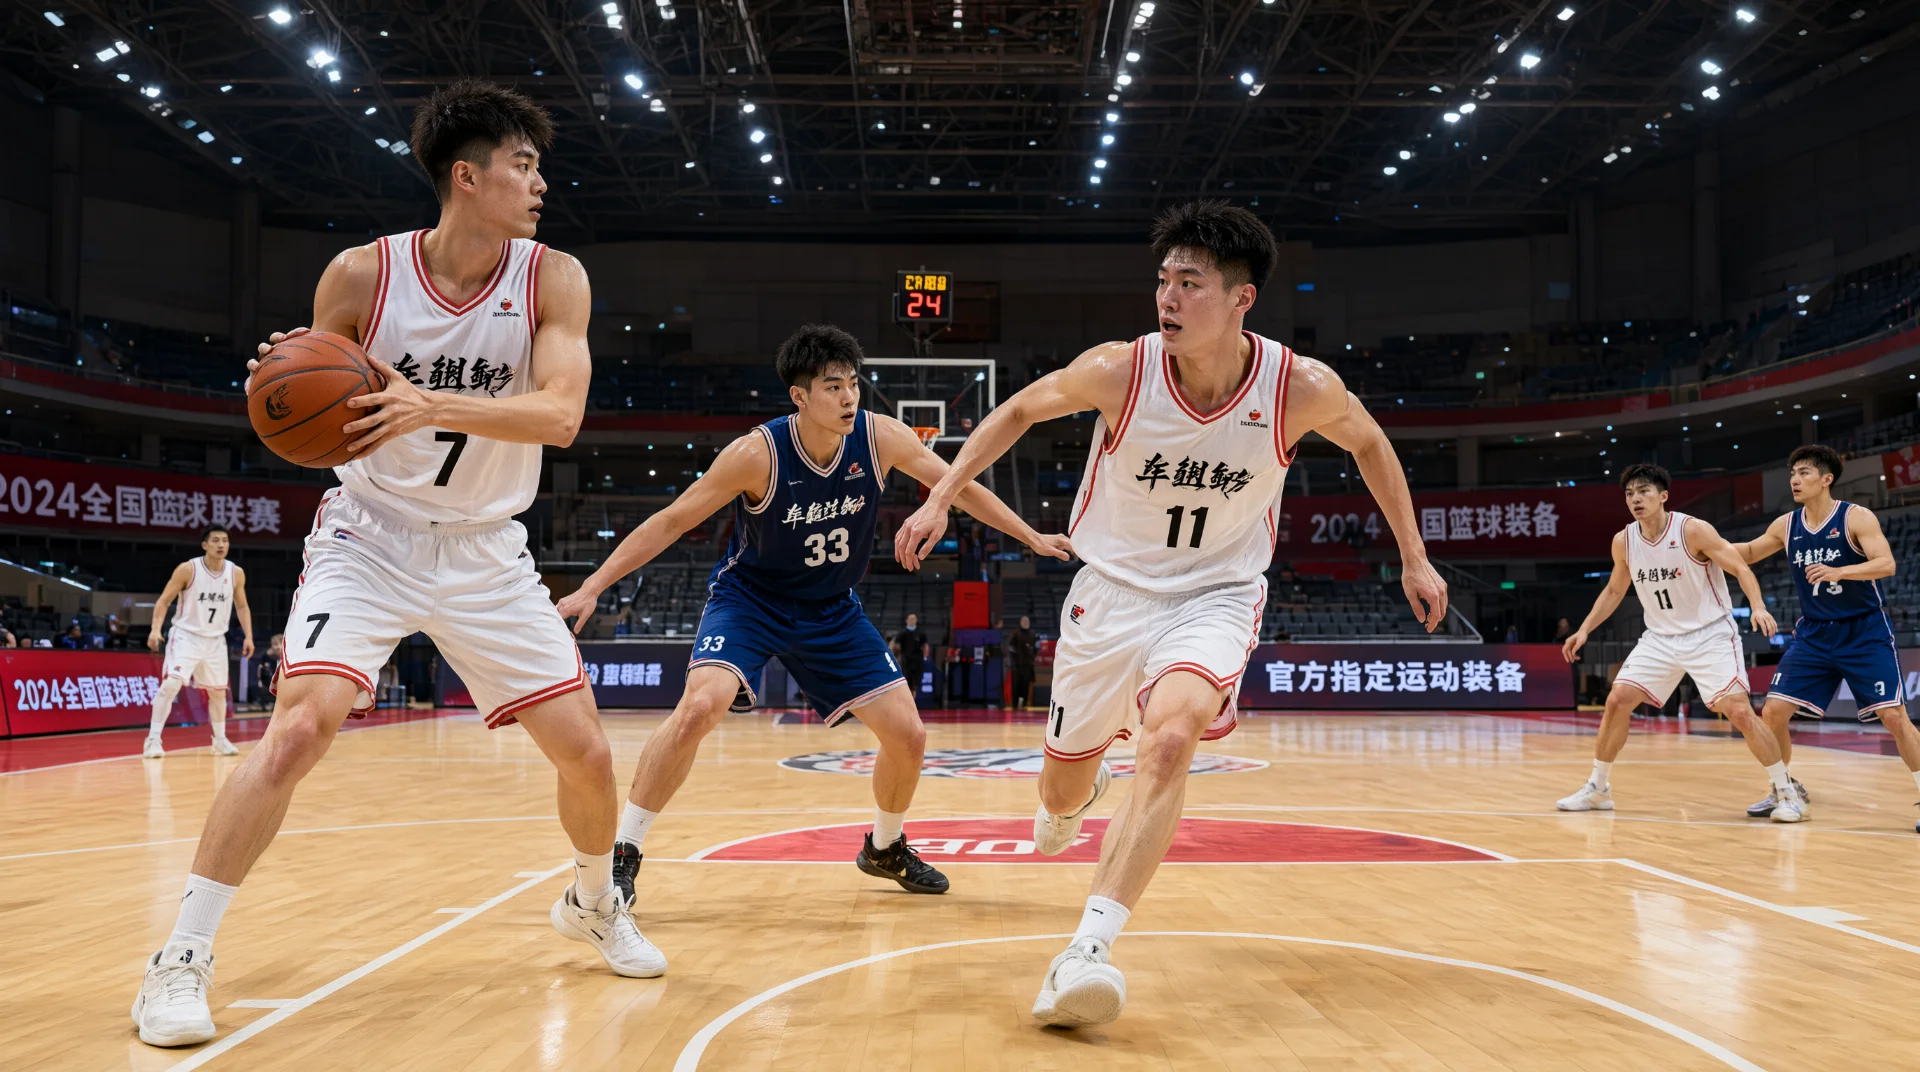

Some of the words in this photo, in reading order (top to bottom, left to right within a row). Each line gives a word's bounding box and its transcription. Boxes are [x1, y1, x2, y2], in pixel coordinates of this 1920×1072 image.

[907, 292, 941, 317] 24
[434, 431, 468, 486] 7
[1166, 505, 1209, 549] 11
[804, 527, 850, 567] 33
[1654, 588, 1673, 610] 11
[208, 608, 216, 623] 7
[305, 613, 330, 649] 7
[698, 635, 725, 652] 33
[1265, 660, 1526, 692] 官方指定运动装备
